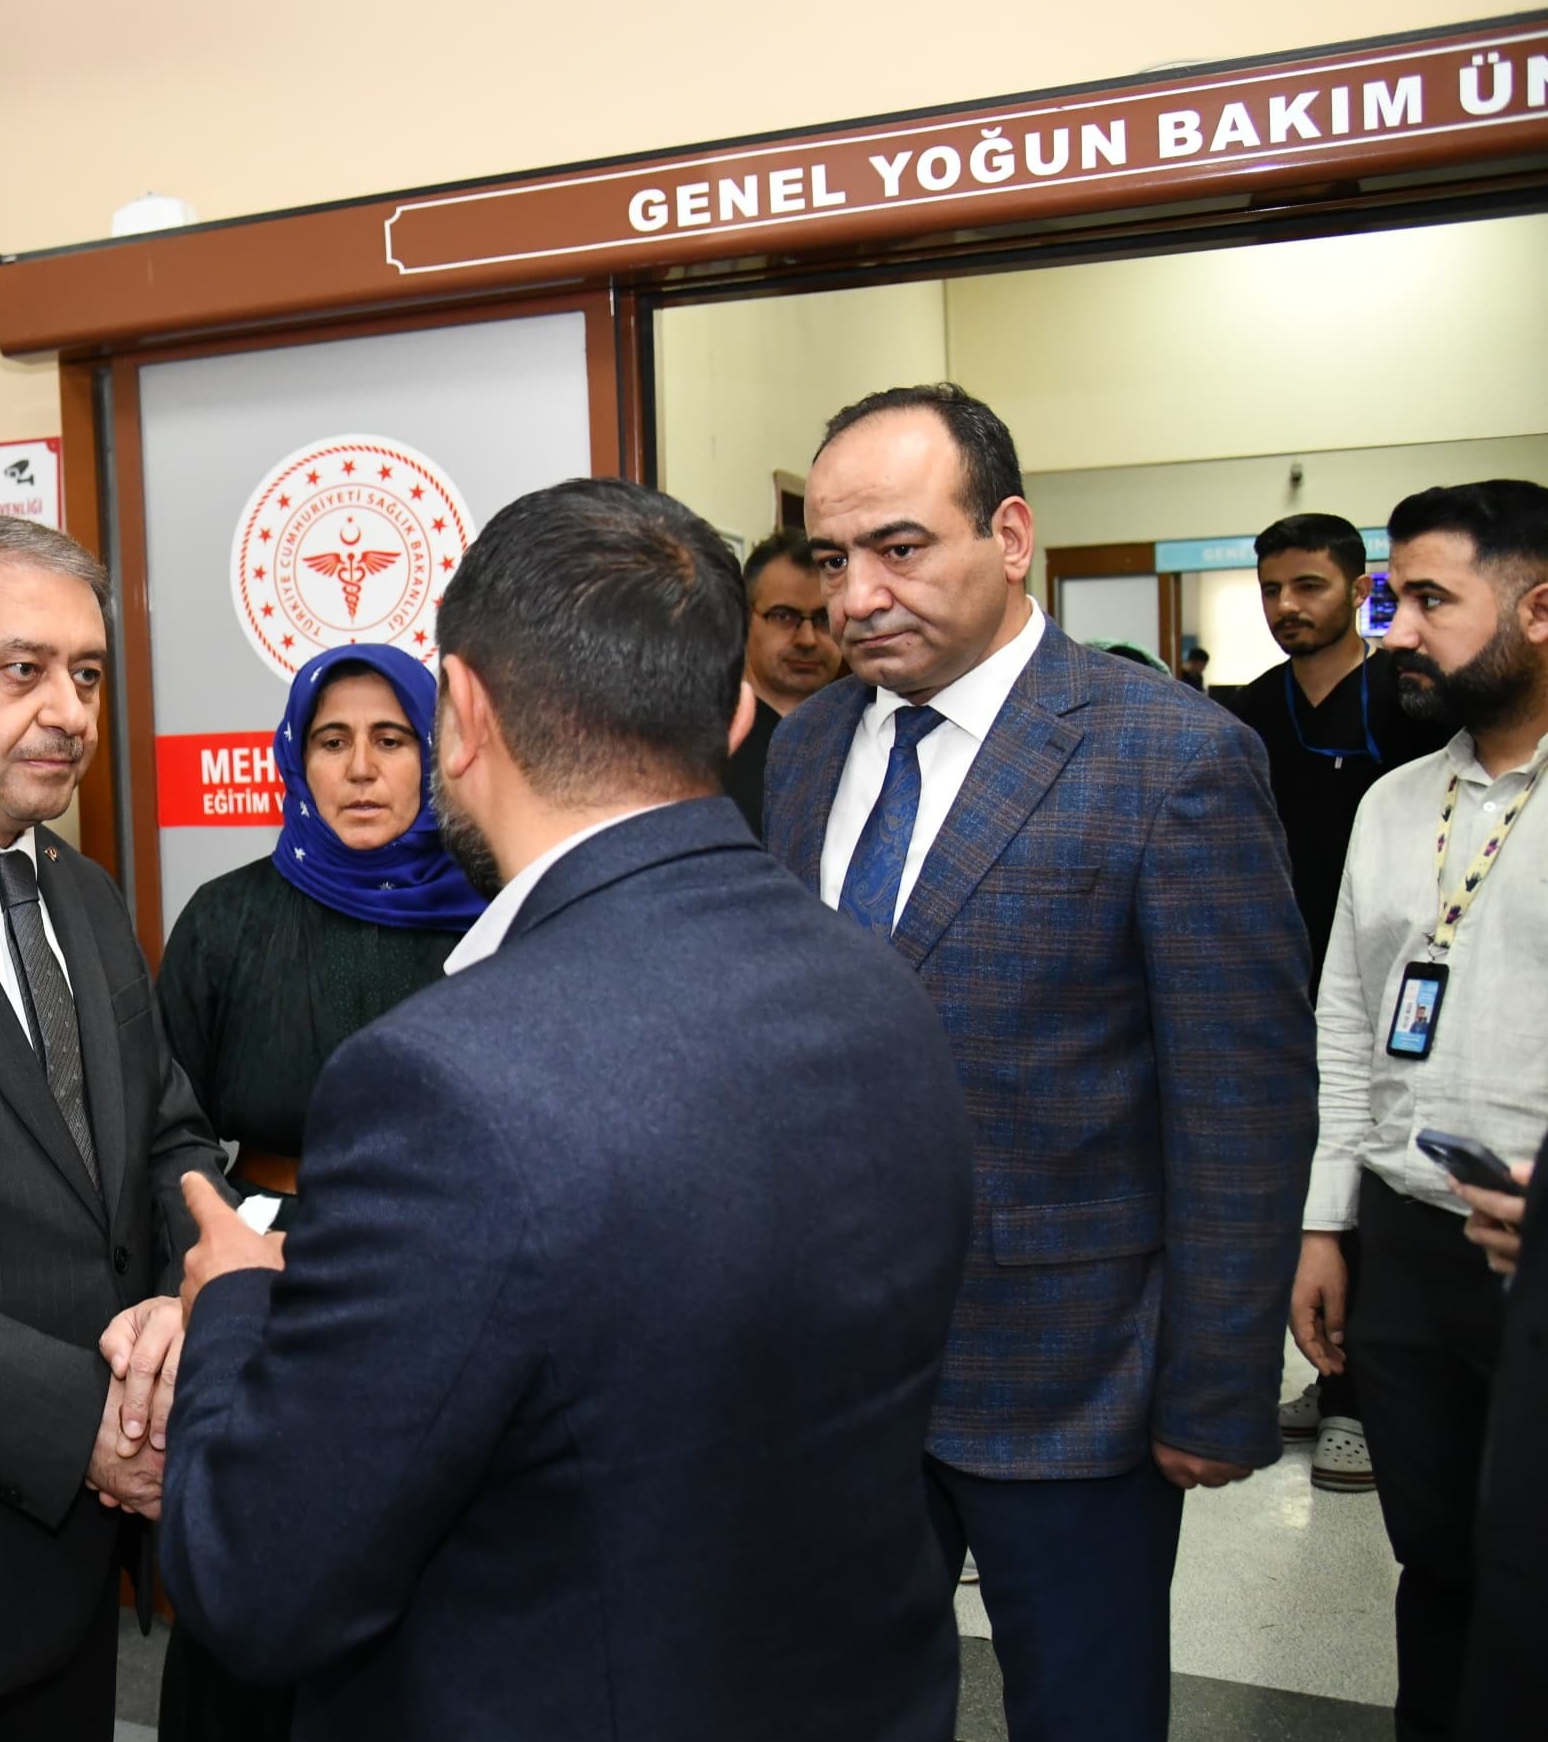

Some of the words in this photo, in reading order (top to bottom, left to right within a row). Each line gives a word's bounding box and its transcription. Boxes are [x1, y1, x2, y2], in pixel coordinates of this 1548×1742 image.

[628, 164, 846, 231] GENEL
[869, 118, 1129, 198] YOĞUN
[1158, 75, 1424, 159] BAKIM
[280, 489, 361, 568] CUMHURİYETİ
[367, 492, 415, 536] SAĞLIK
[280, 575, 322, 637] TÜRKİYE
[388, 540, 426, 631] BAKANLIĞI
[200, 746, 283, 784] MEH
[202, 787, 270, 815] EĞİTİM
[273, 791, 286, 814] V
